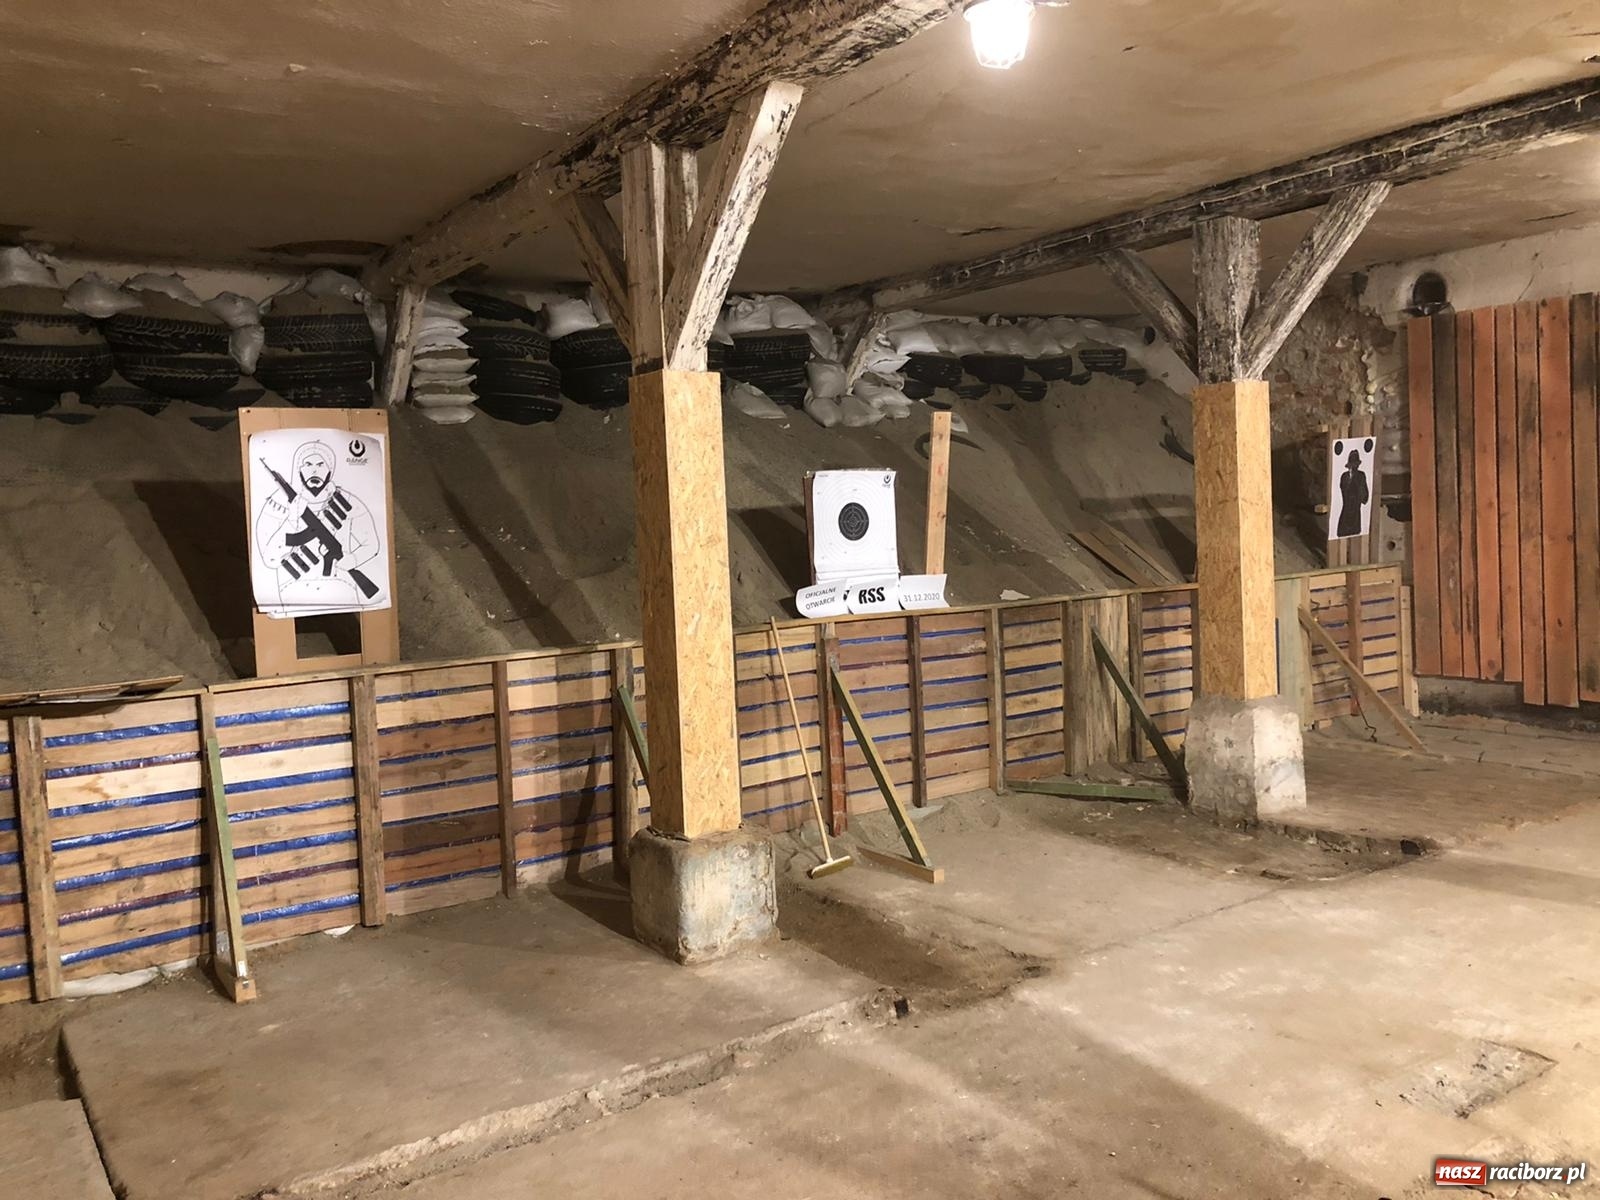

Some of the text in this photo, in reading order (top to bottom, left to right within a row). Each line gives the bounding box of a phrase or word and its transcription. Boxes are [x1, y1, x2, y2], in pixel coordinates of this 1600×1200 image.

[805, 587, 837, 599] OFICIALNE
[858, 586, 886, 604] RSS
[805, 596, 835, 610] OTWARCIE
